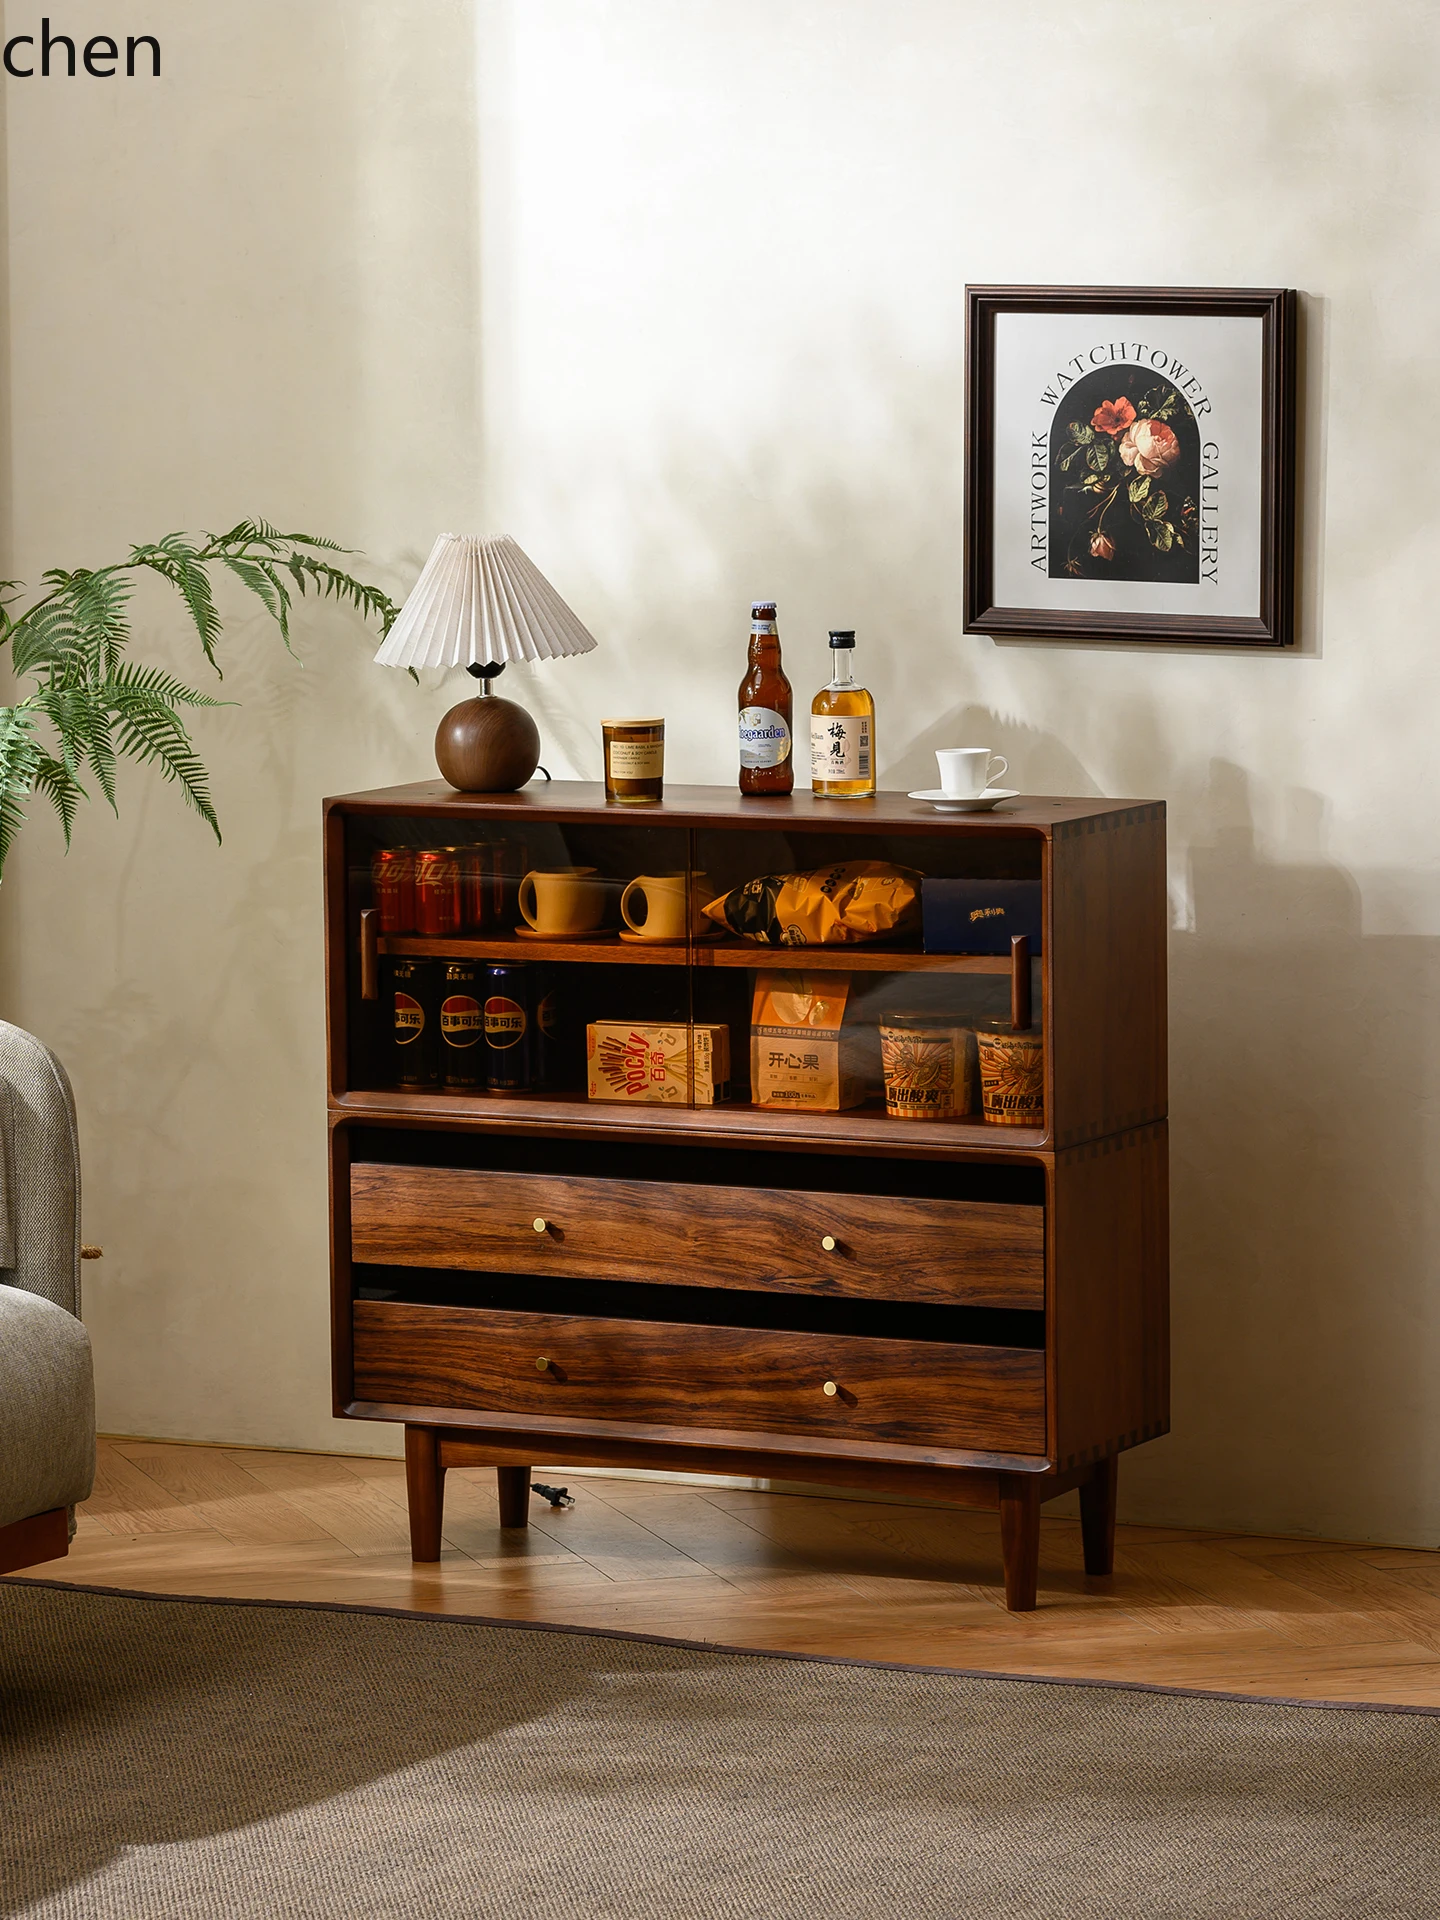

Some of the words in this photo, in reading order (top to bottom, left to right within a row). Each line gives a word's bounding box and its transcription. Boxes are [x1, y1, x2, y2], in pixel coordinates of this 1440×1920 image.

[1030, 431, 1048, 572] ARTWORK
[1040, 342, 1212, 417] WATCHTOWER
[1201, 441, 1220, 585] GALLERY
[739, 725, 786, 741] oegaarden
[442, 1014, 483, 1028] 百事可乐
[650, 1051, 666, 1082] 百奇
[768, 1052, 820, 1070] 开心果
